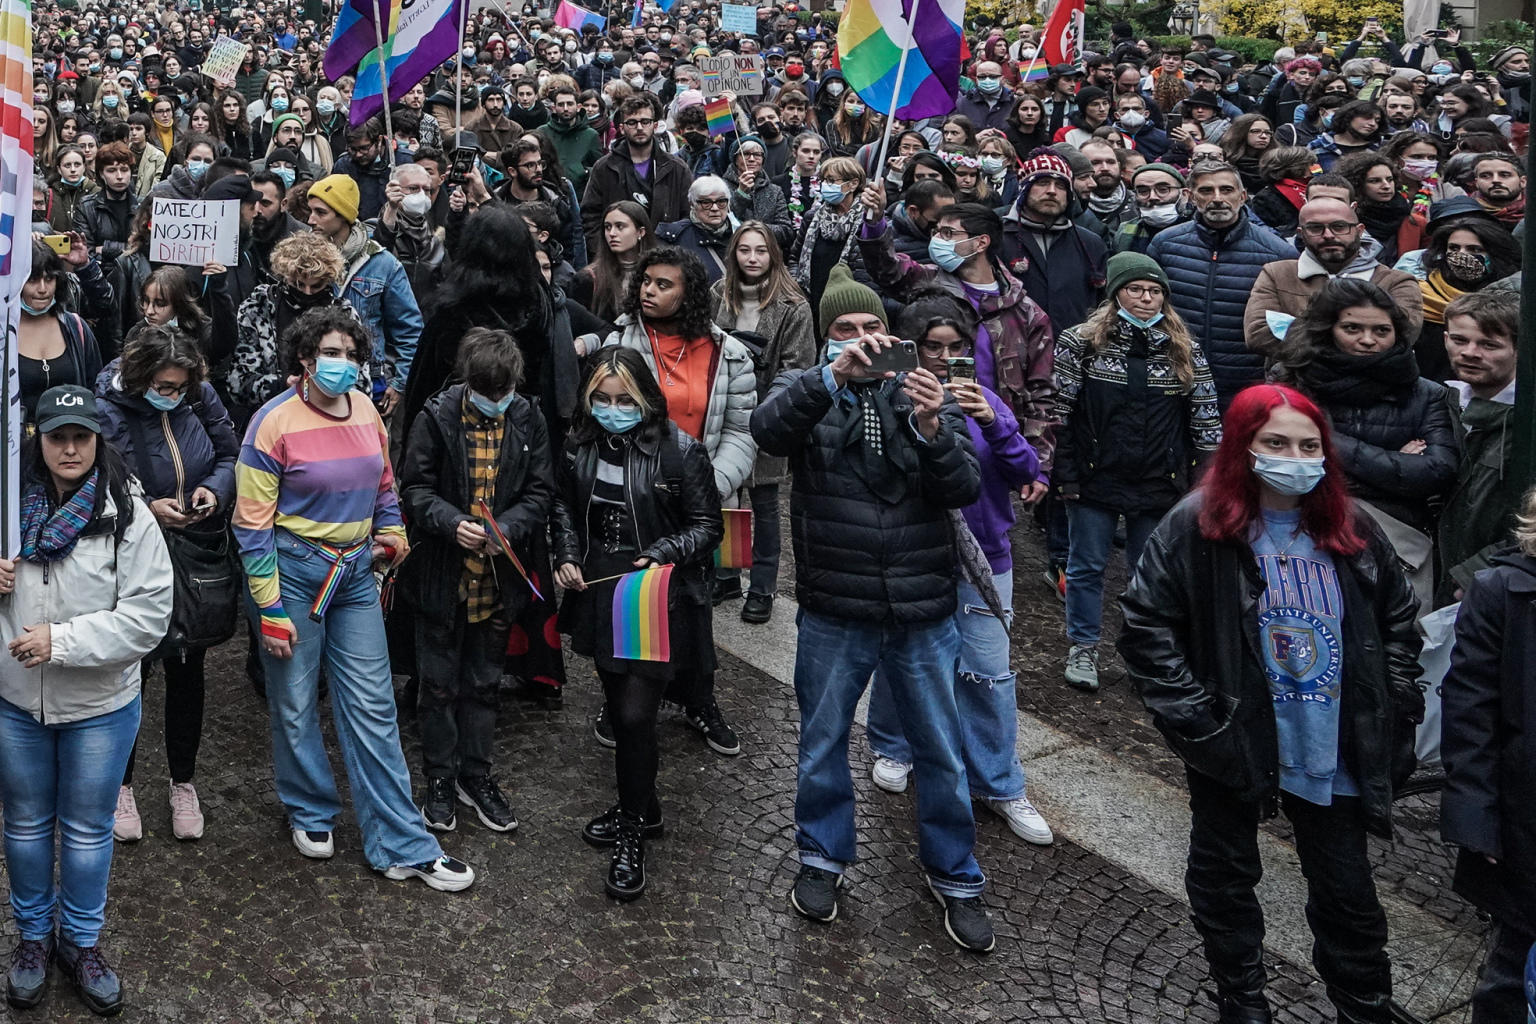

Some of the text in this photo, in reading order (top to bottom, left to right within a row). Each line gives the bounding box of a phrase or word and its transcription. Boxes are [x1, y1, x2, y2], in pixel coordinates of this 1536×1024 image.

[734, 57, 755, 69] NON
[1271, 608, 1311, 621] STATE
[1312, 619, 1340, 687] UNIVERSITY
